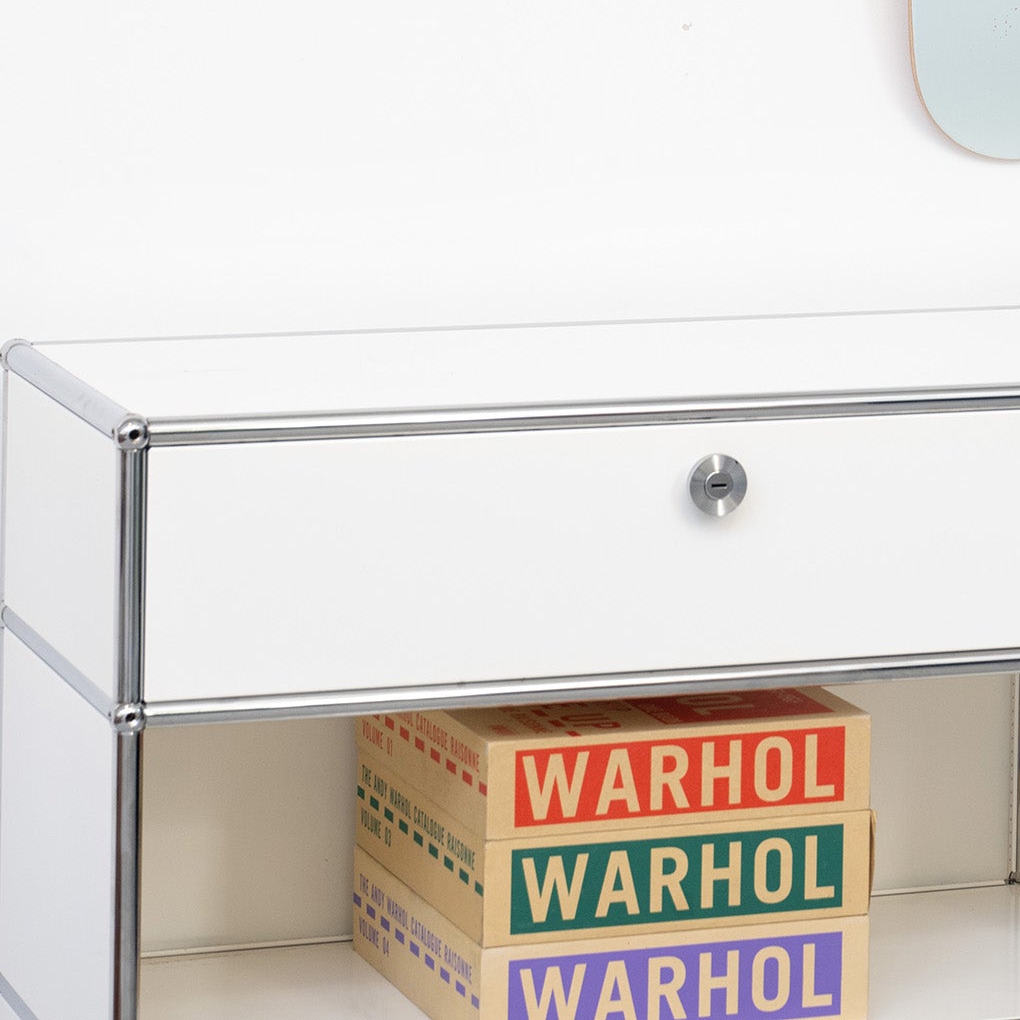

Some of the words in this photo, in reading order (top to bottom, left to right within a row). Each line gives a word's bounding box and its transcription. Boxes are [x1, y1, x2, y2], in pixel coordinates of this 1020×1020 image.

[362, 719, 383, 750] VOLUME
[387, 737, 393, 757] 01
[416, 712, 447, 751] CATALOGUE
[451, 736, 479, 772] RAISONNE
[521, 733, 835, 820] WARHOL
[361, 807, 381, 839] VOLUME
[385, 826, 391, 848] 03
[362, 764, 371, 787] THE
[373, 774, 387, 800] ANDY
[390, 785, 411, 819] WARHOL
[414, 806, 445, 846] CATALOGUE
[447, 832, 475, 871] RAISONNE
[521, 835, 835, 924] WARHOL
[360, 873, 369, 897] THE
[371, 883, 385, 909] ANDY
[387, 895, 408, 930] WARHOL
[411, 917, 441, 958] CATALOGUE
[444, 944, 472, 984] RAISONNE
[360, 916, 379, 949] VOLUME
[382, 936, 389, 957] 04
[519, 943, 834, 1020] WARHOL
